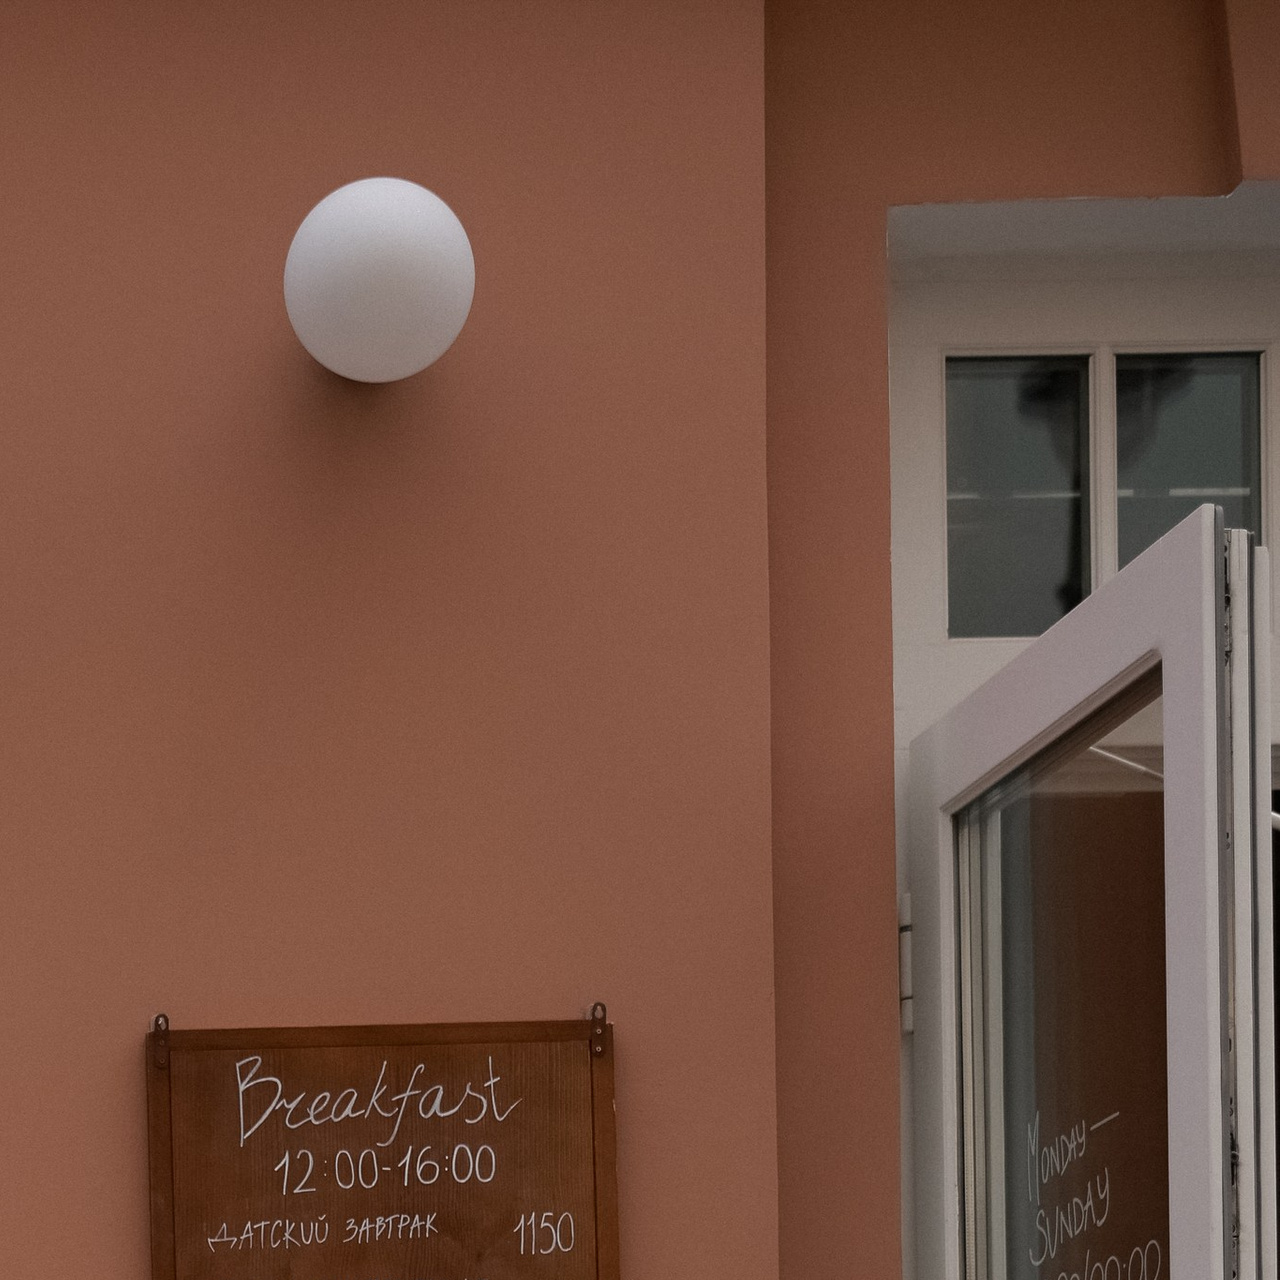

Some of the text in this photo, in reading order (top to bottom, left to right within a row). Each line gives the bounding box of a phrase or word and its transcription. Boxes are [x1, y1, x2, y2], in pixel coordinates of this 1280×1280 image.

[236, 1056, 523, 1147] Breakfast
[274, 1144, 496, 1196] 12:00-16:00
[208, 1212, 575, 1255] ДАТСКИЙ ЗАВТРАК 1150
[1029, 1167, 1110, 1267] SUNDAY
